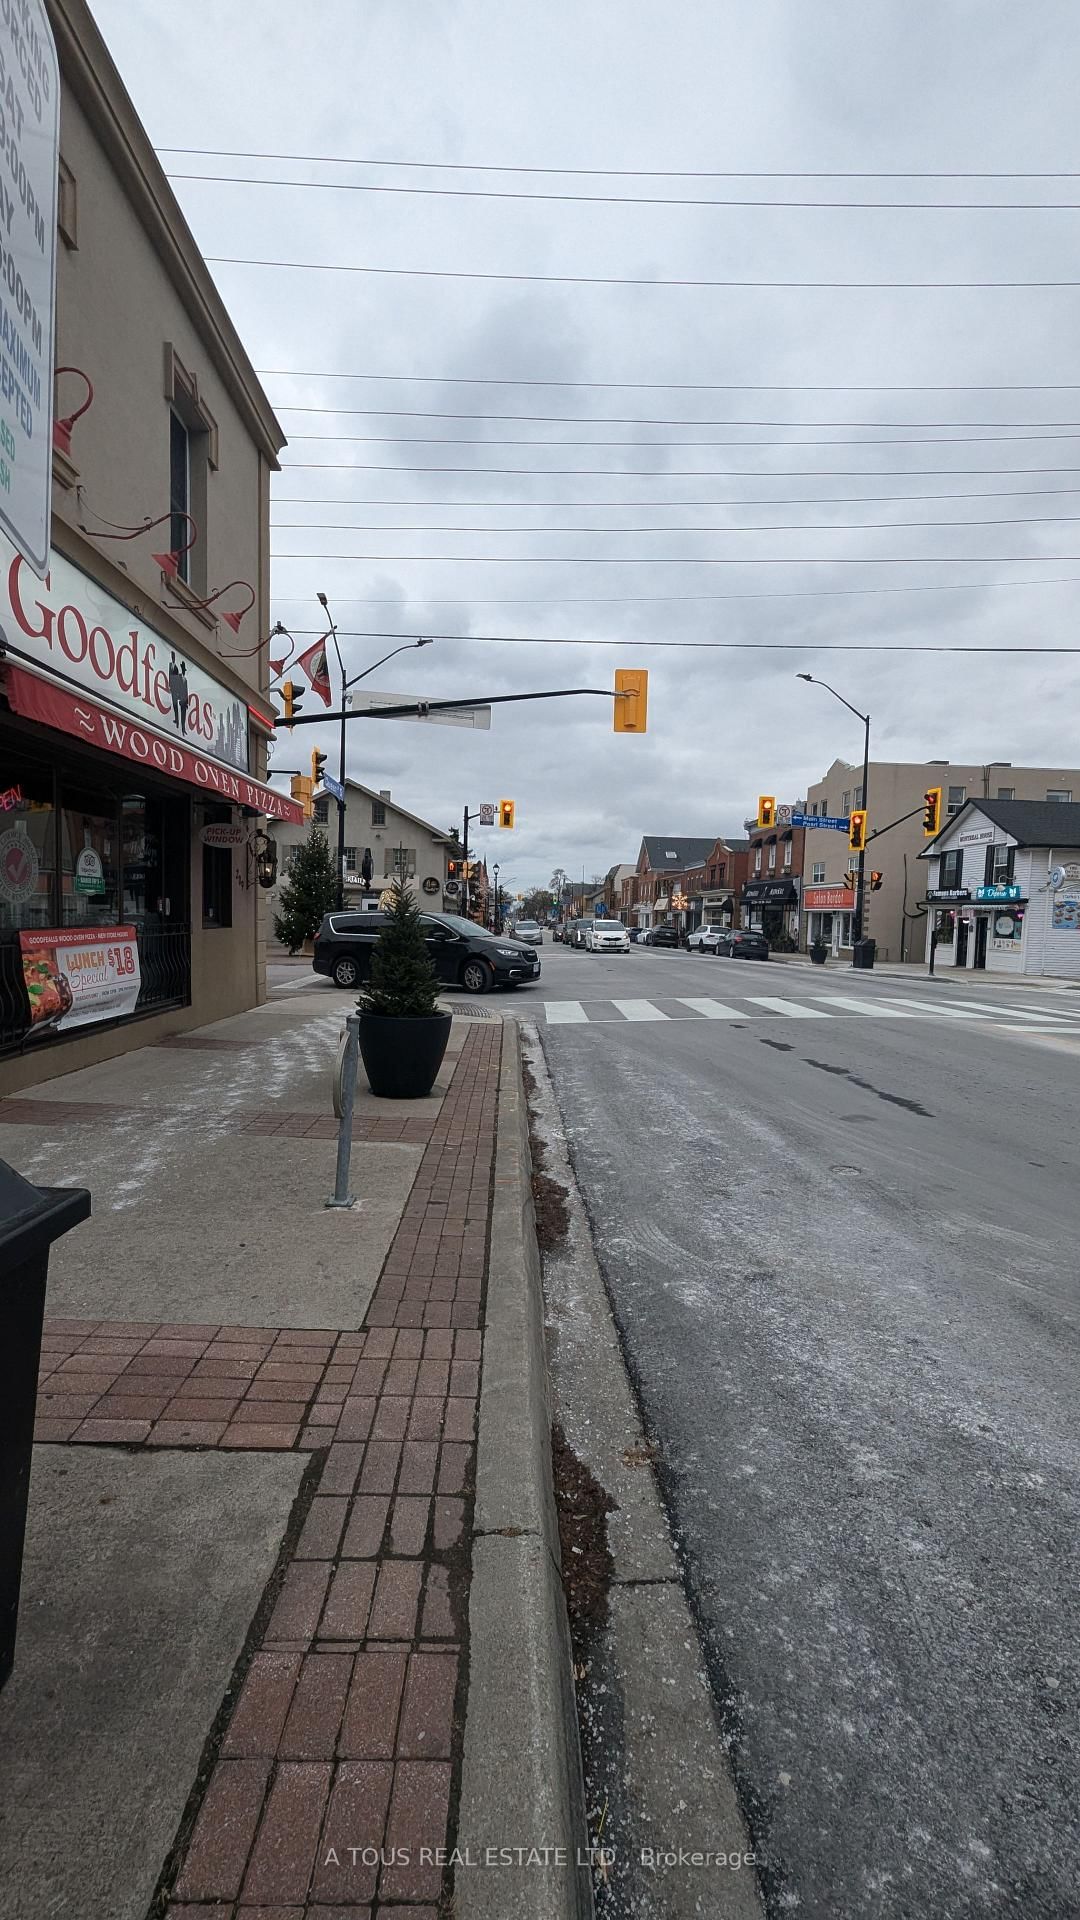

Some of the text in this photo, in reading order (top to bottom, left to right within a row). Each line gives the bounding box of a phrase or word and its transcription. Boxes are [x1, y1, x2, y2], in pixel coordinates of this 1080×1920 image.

[18, 0, 49, 103] KING
[0, 356, 33, 440] EPTED
[9, 554, 213, 740] Goodfeas
[100, 714, 283, 816] WOOD OVEN PIZZA
[204, 835, 244, 843] WINDOW
[207, 827, 241, 836] PICK-UP
[66, 946, 136, 976] LUNCH $18
[70, 966, 108, 992] Special
